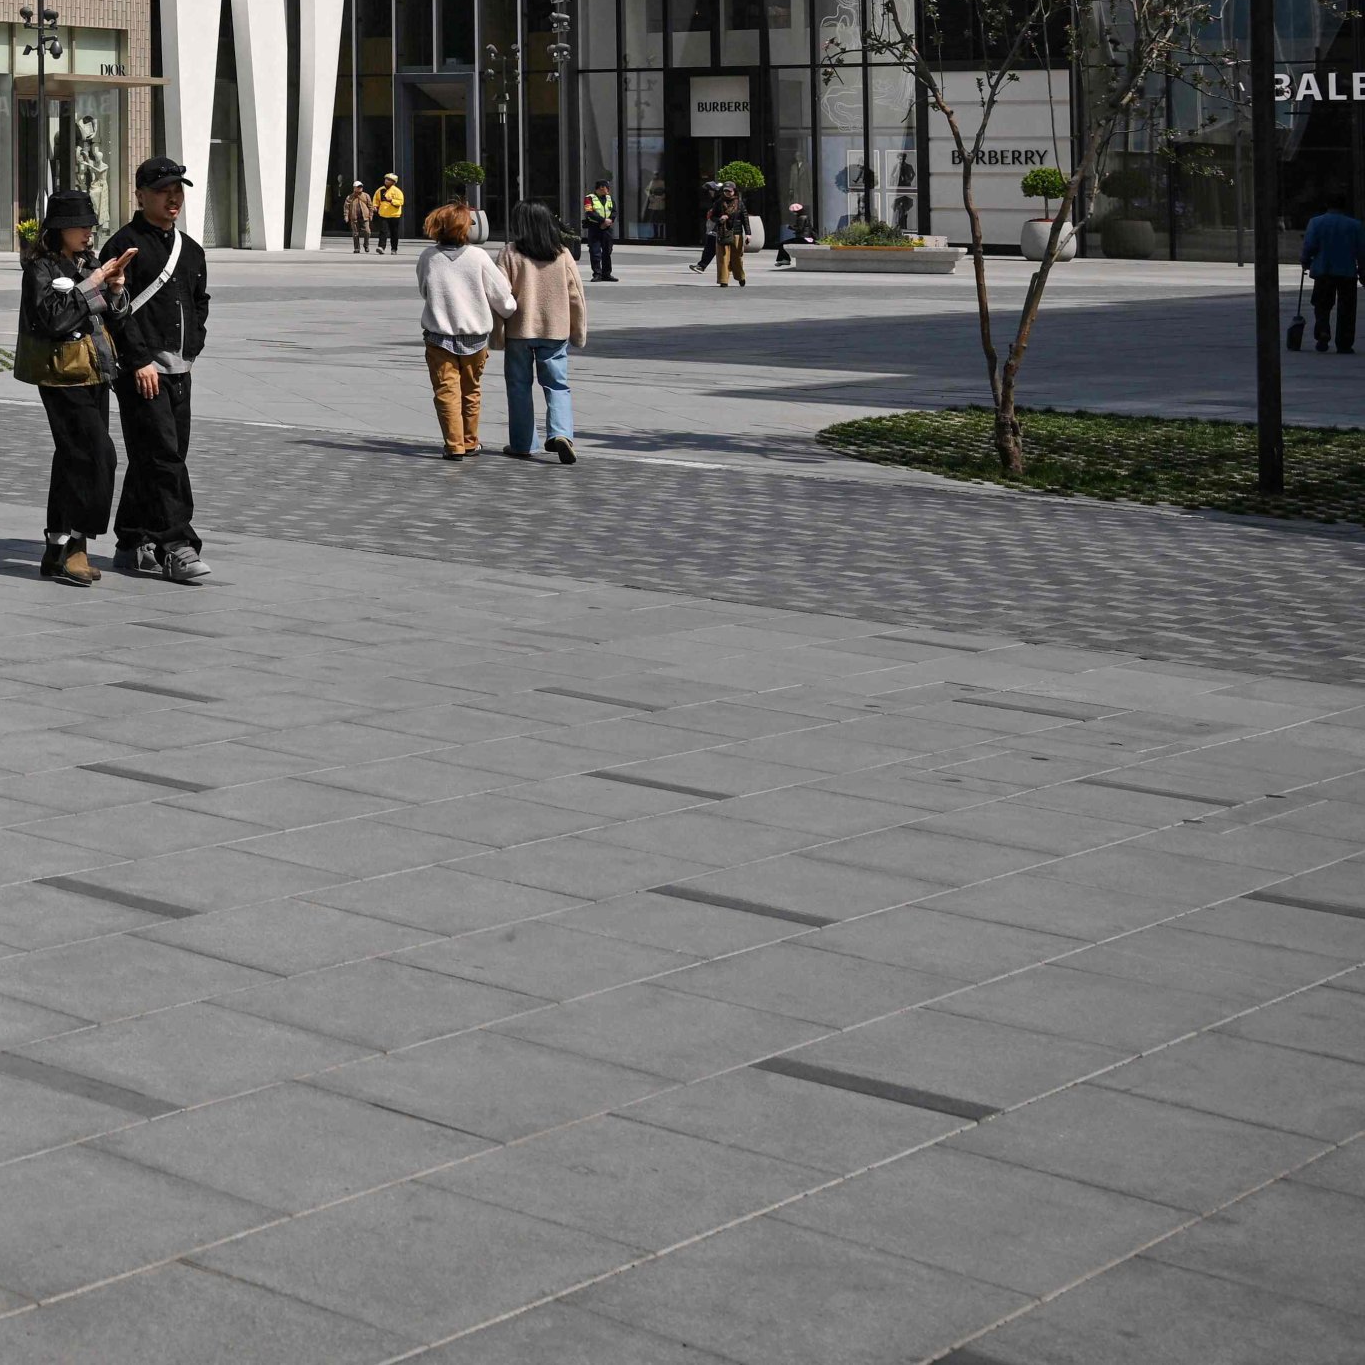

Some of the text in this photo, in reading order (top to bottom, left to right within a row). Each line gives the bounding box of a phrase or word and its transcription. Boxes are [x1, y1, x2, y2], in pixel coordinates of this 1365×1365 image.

[100, 63, 126, 76] DIOR
[697, 101, 750, 112] BURBERR
[951, 149, 1047, 165] BRBERRY
